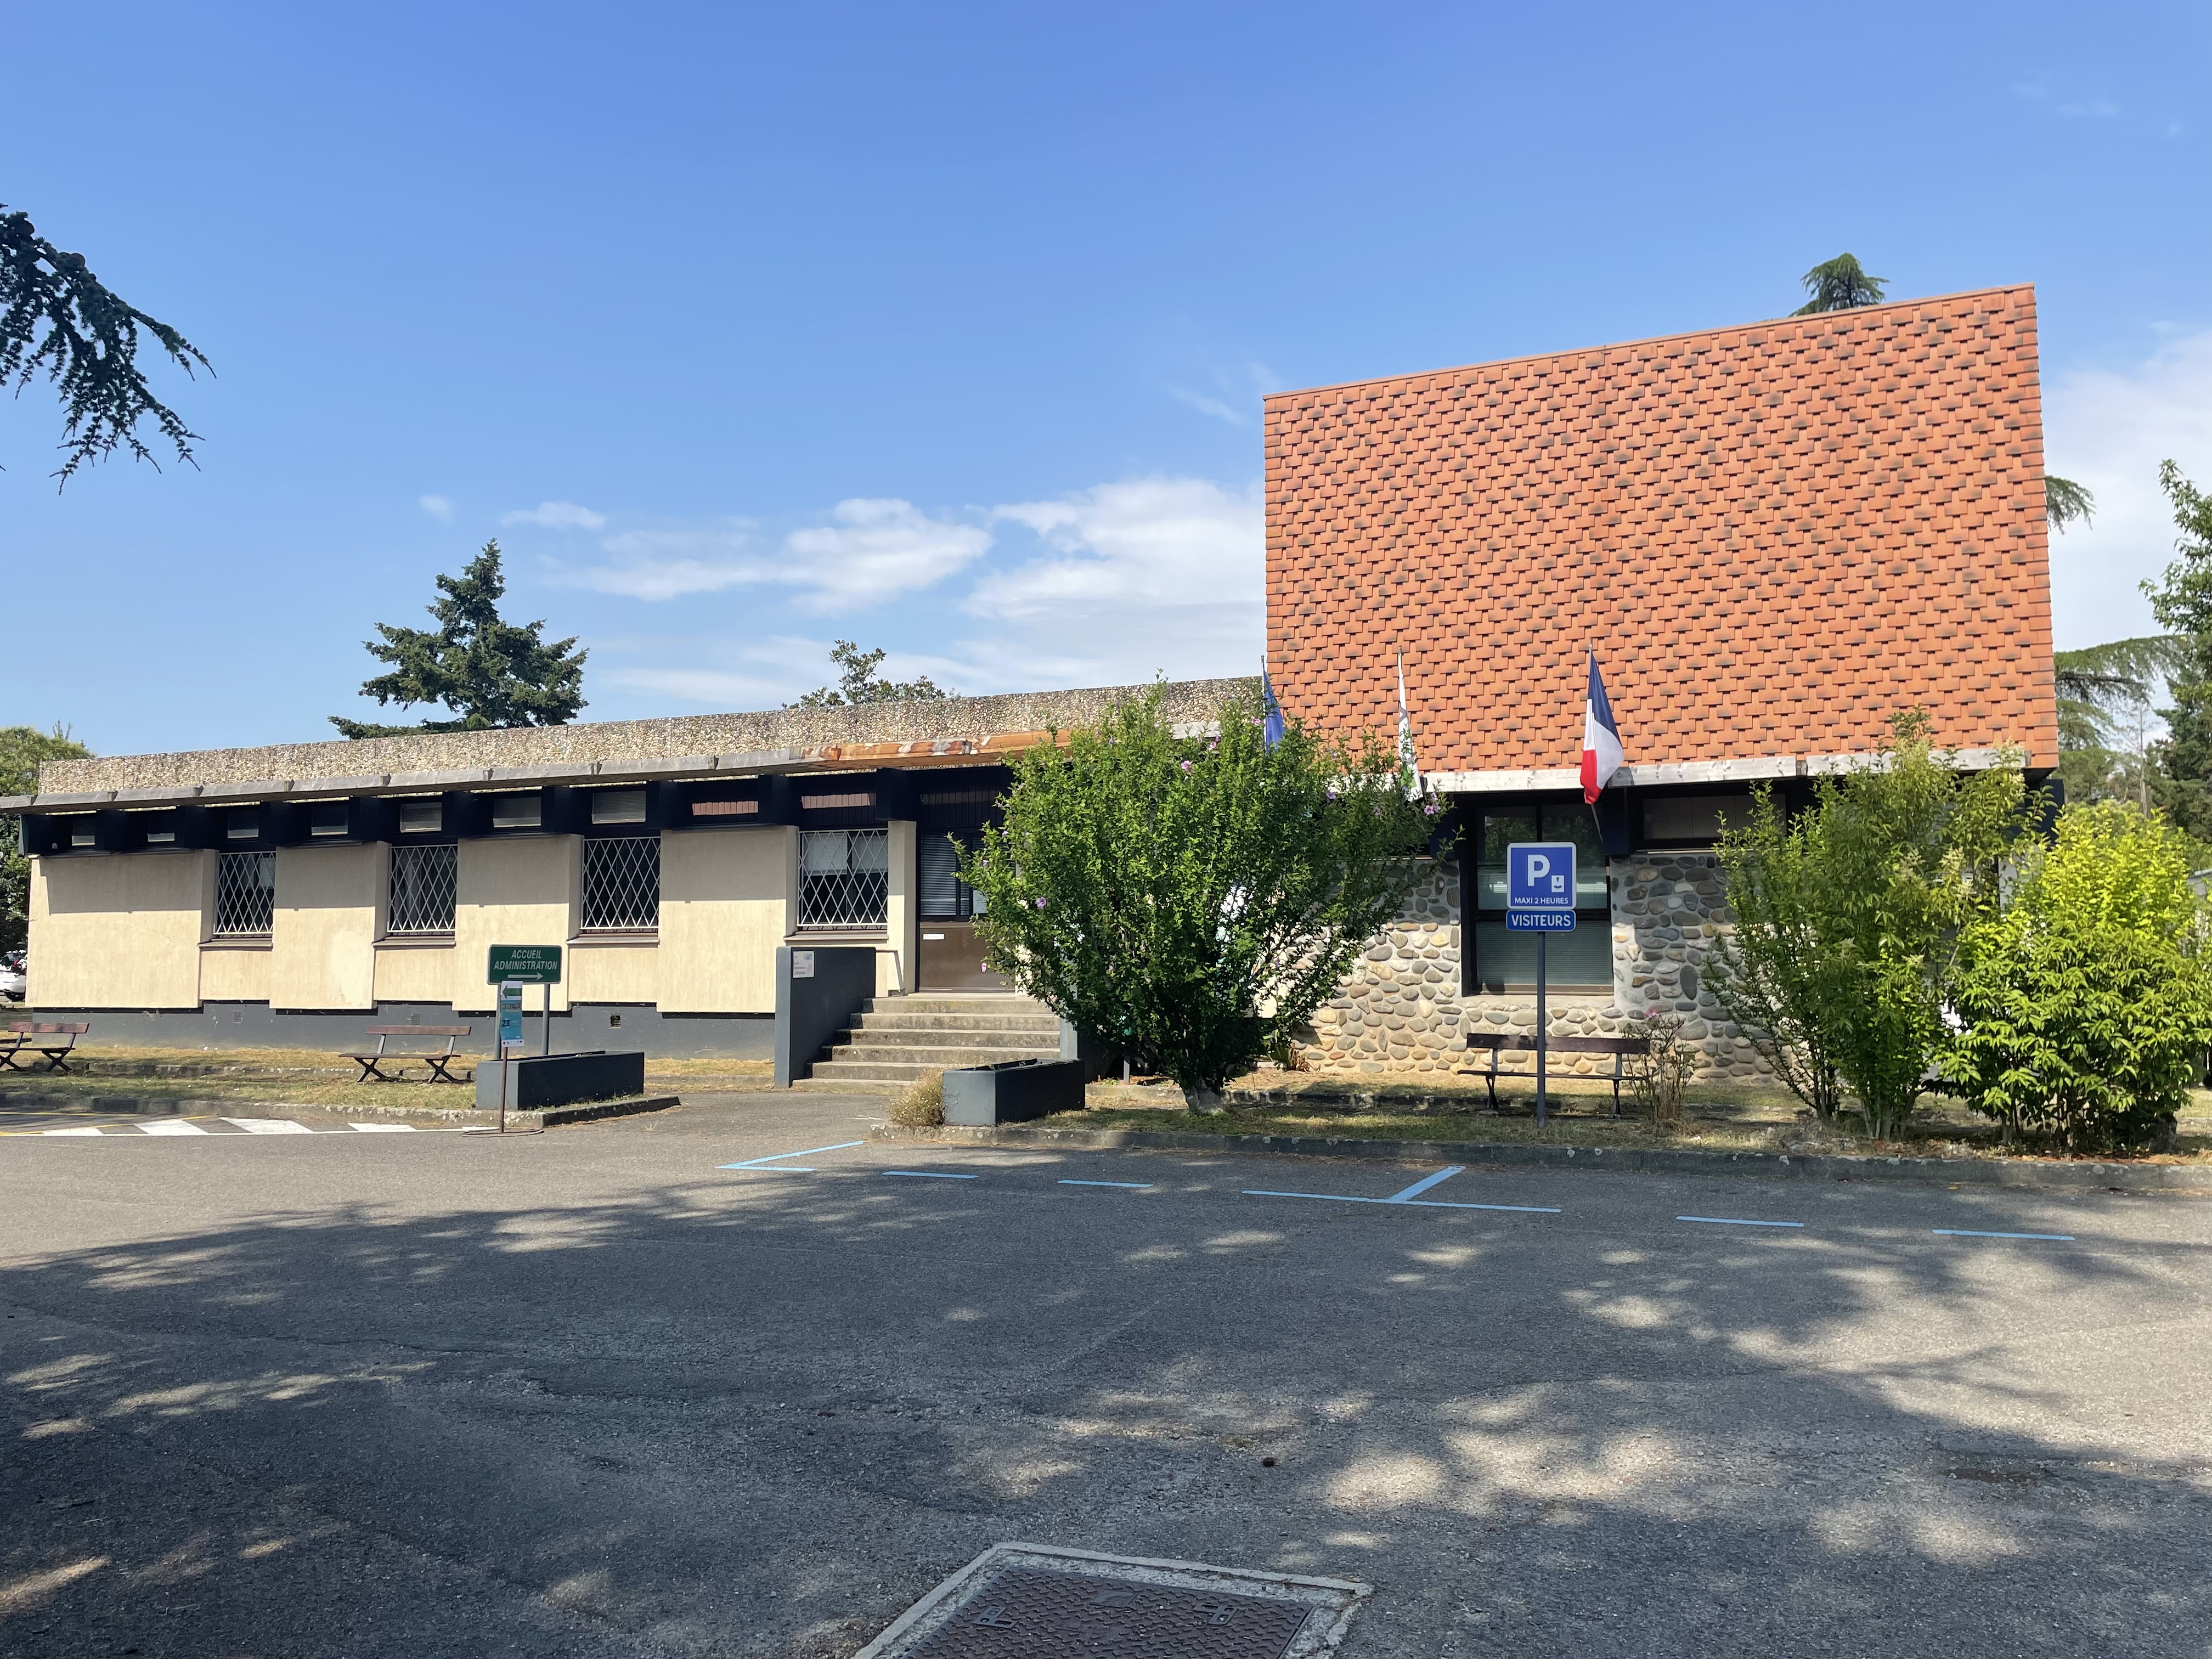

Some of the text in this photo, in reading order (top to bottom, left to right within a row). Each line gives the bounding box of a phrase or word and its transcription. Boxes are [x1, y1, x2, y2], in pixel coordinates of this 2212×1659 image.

[1527, 854, 1550, 887] P
[1511, 915, 1571, 927] VISITEURS
[511, 950, 541, 959] ACCUEIL
[494, 961, 557, 970] ADMINISTRATION
